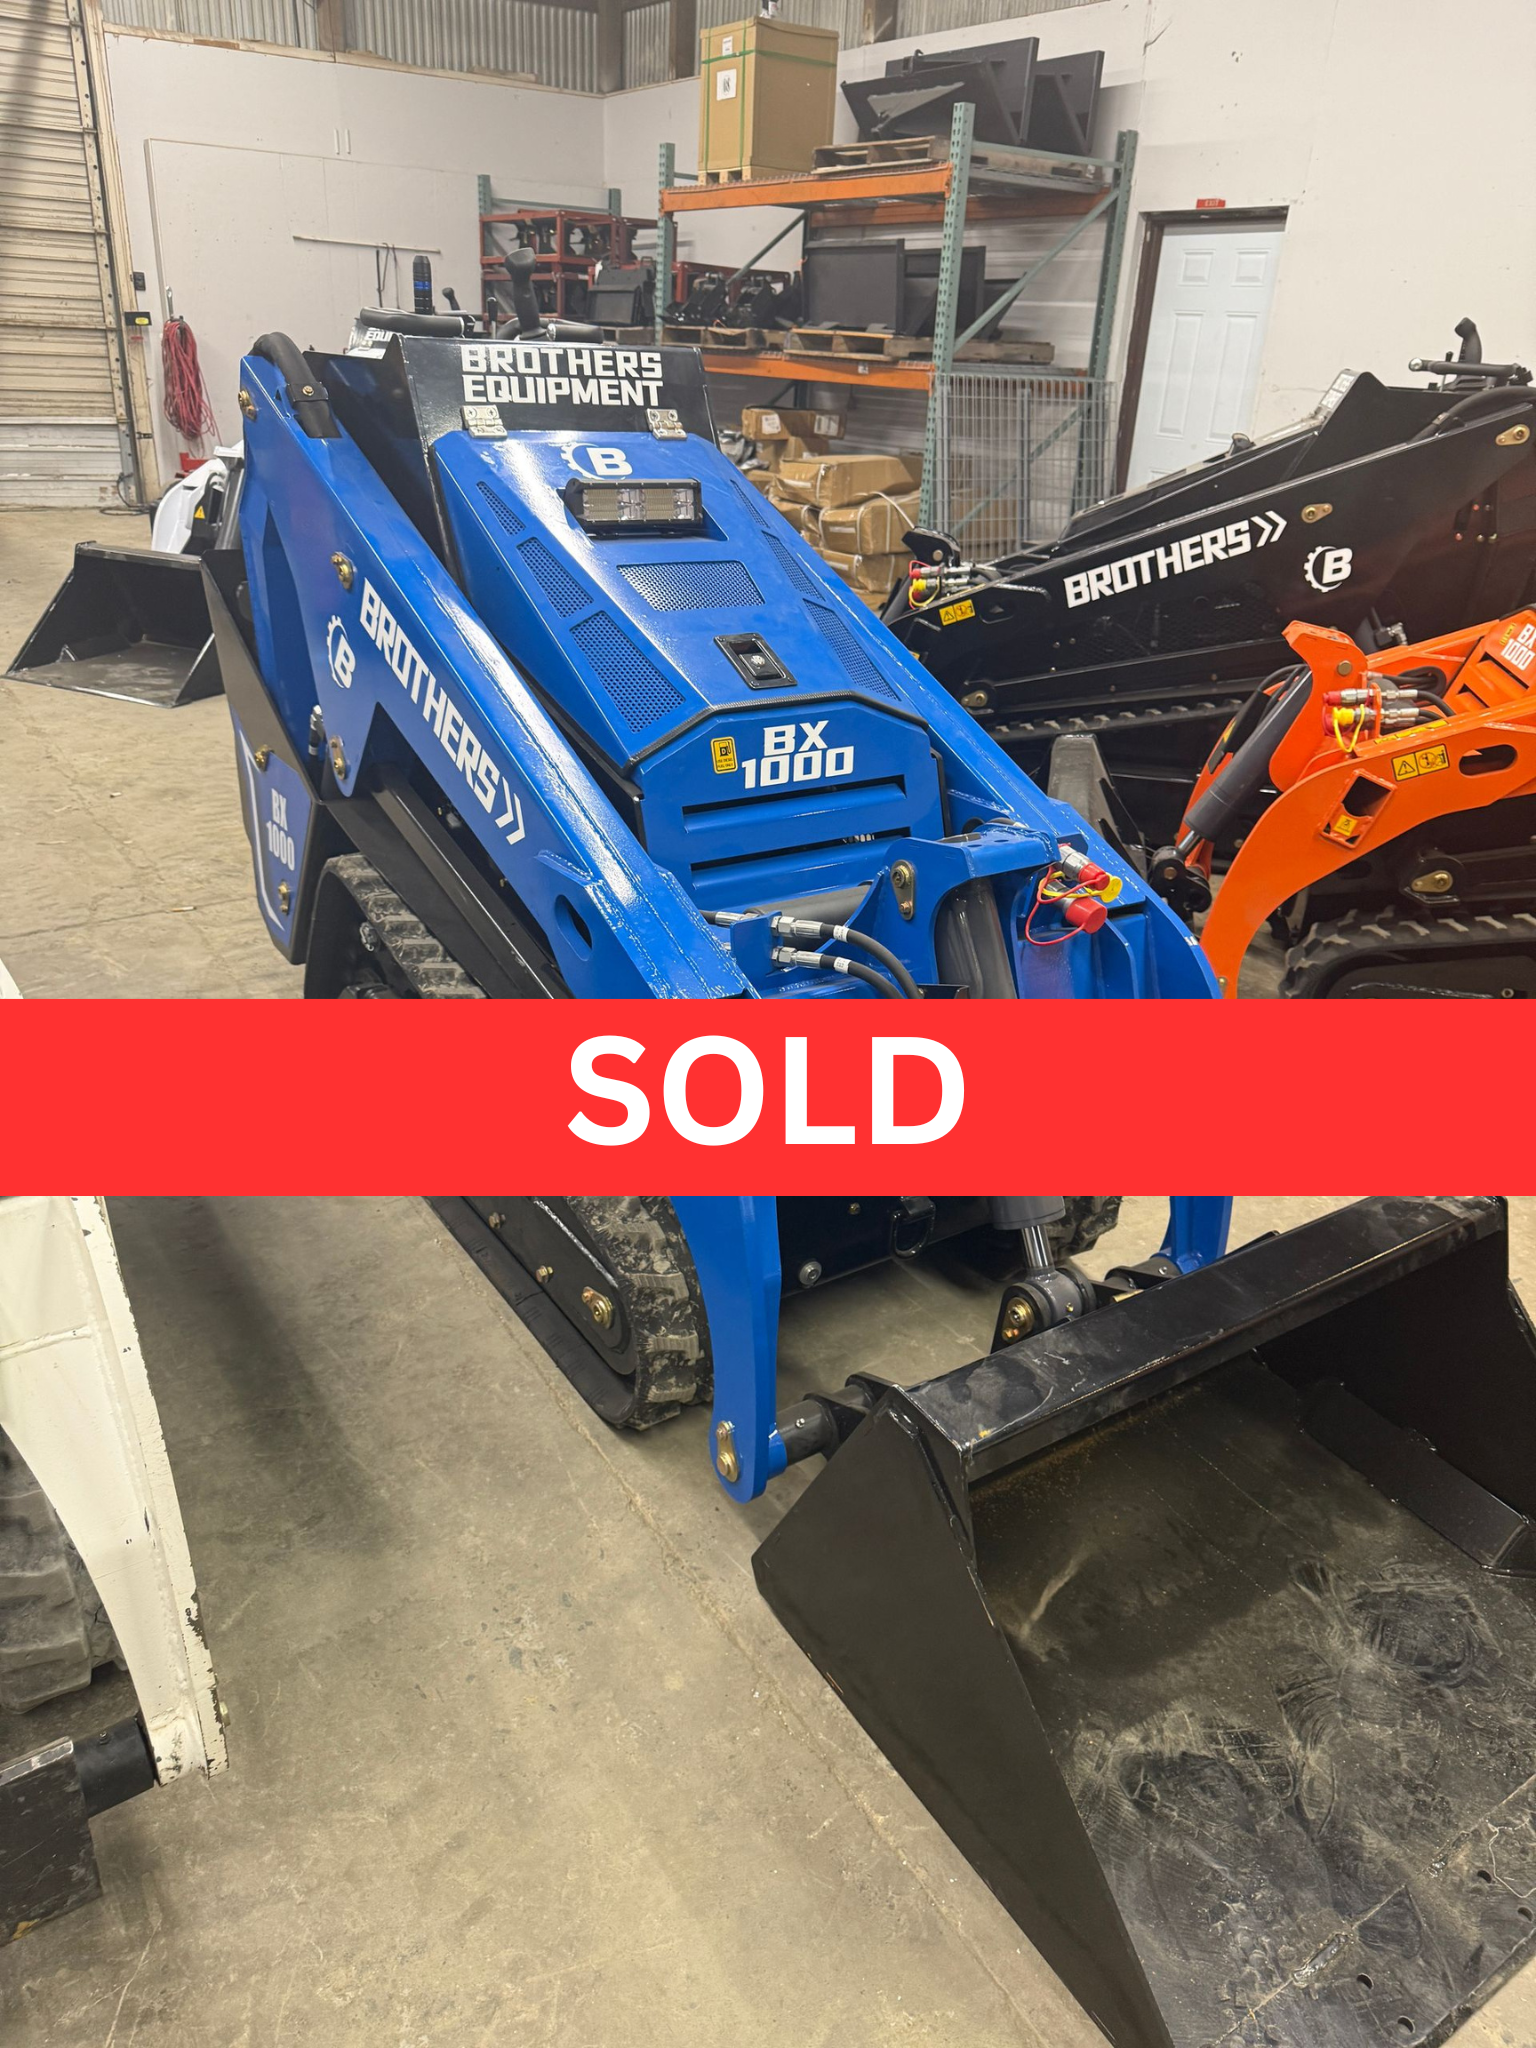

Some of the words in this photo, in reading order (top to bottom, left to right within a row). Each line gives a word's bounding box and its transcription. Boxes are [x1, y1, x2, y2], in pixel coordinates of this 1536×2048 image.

[461, 345, 664, 379] BROTHERS
[462, 374, 664, 407] EQUIPMENT
[585, 447, 633, 476] B
[1063, 519, 1252, 609] BROTHERS
[1321, 547, 1353, 584] B
[334, 634, 356, 689] B
[1500, 638, 1536, 671] 1000
[360, 577, 500, 814] BROTHERS
[763, 720, 829, 756] BX
[741, 745, 854, 789] 1000
[271, 787, 288, 831] BX
[265, 820, 295, 871] 1000
